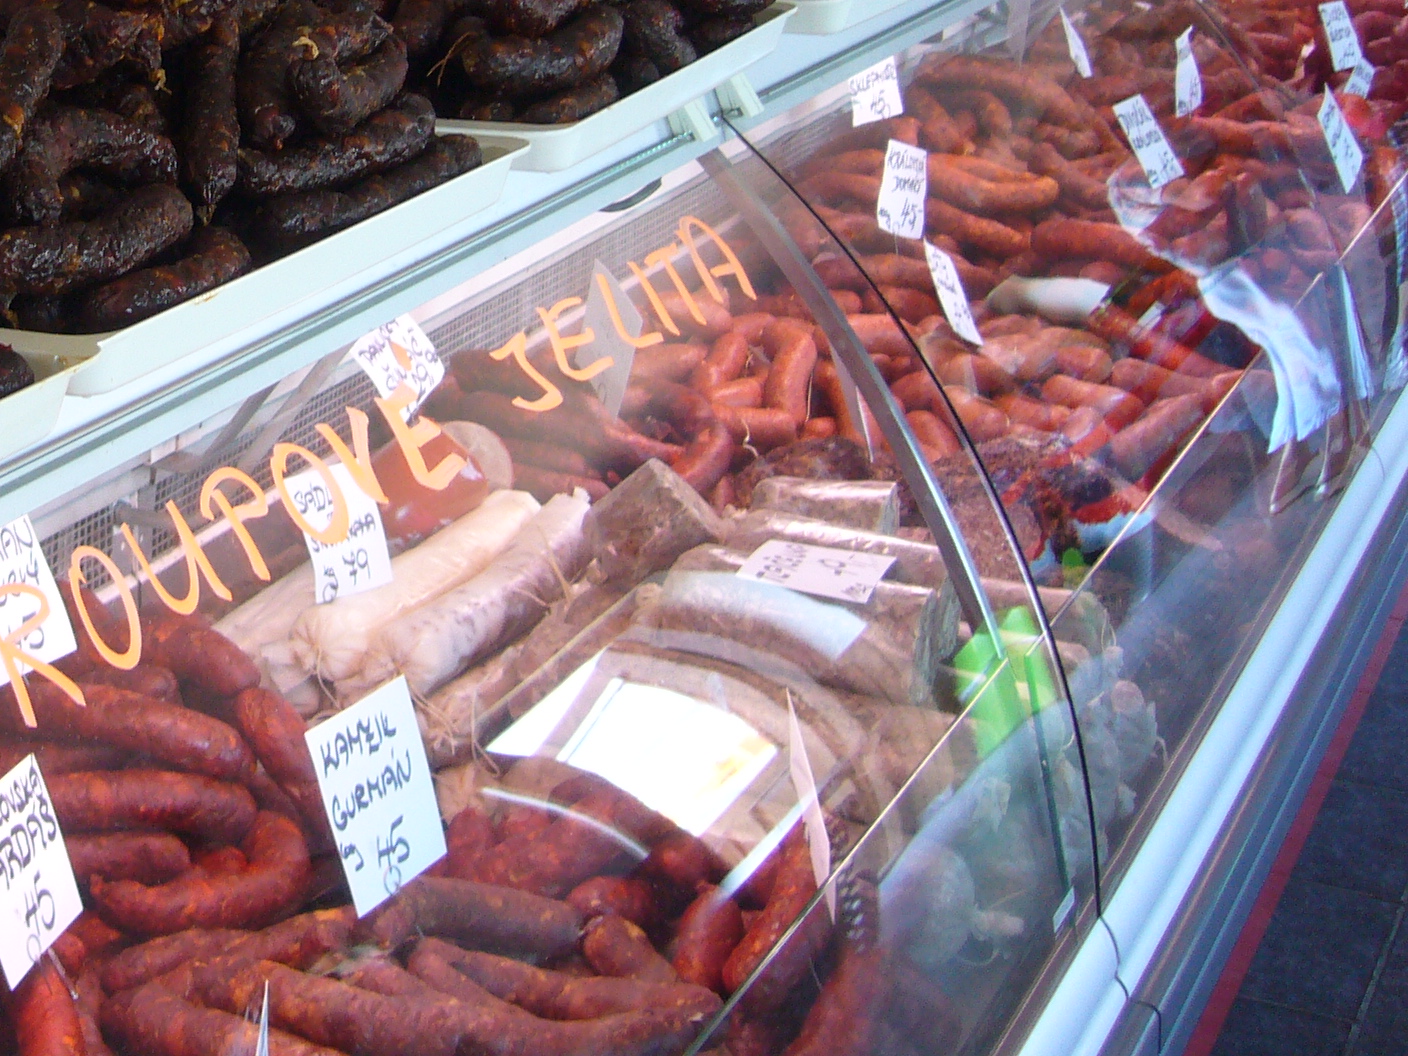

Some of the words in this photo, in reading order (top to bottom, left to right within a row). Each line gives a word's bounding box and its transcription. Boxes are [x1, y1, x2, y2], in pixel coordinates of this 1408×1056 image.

[490, 215, 757, 412] JELITA
[332, 747, 412, 832] GURMÁN
[376, 815, 410, 873] 45
[24, 870, 57, 939] 45
